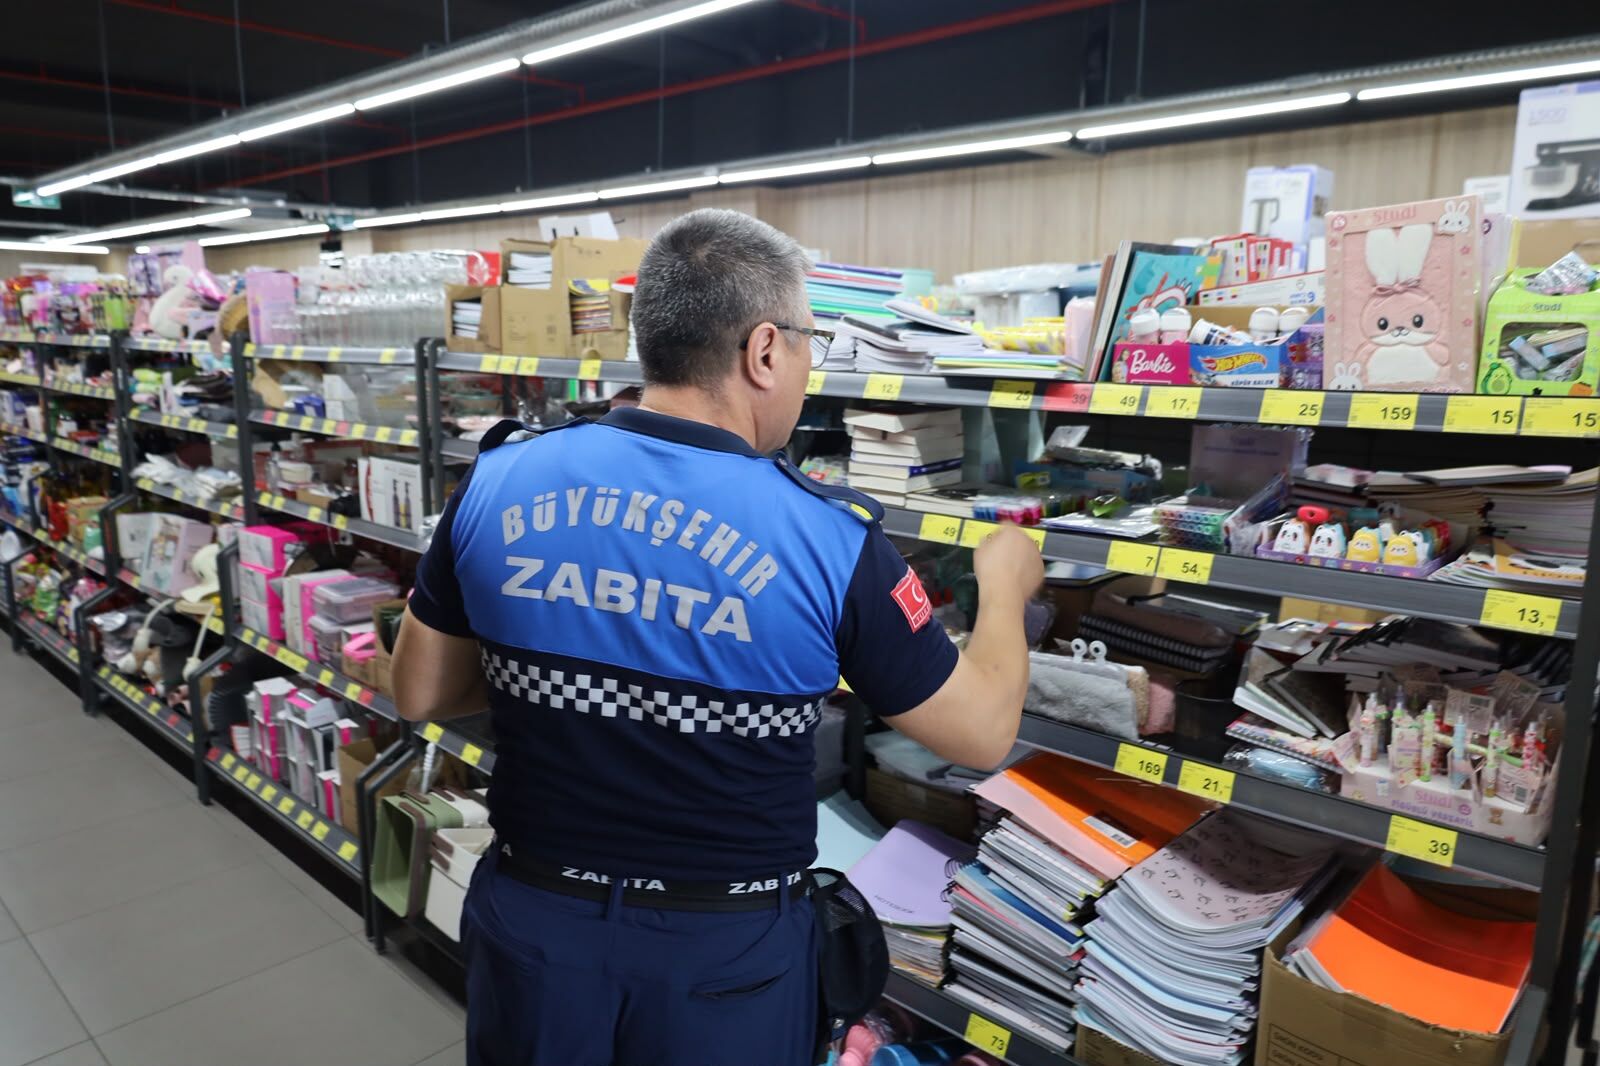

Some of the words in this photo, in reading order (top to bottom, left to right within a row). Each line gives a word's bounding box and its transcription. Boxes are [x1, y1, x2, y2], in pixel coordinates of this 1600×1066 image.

[1130, 350, 1176, 374] Barbie
[1016, 390, 1031, 401] 25
[1072, 394, 1087, 404] 39
[1120, 396, 1136, 407] 49
[1299, 404, 1318, 416] 25
[1381, 407, 1411, 420] 159
[1491, 410, 1514, 424] 15
[1572, 413, 1597, 427] 15
[502, 486, 779, 598] BÜYÜKŞEHİR
[1145, 556, 1153, 567] 7
[501, 555, 752, 643] ZABITA
[1139, 760, 1160, 775] 169
[1429, 840, 1450, 856] 39
[728, 871, 802, 894] ZABTA
[991, 1035, 1005, 1050] 73
